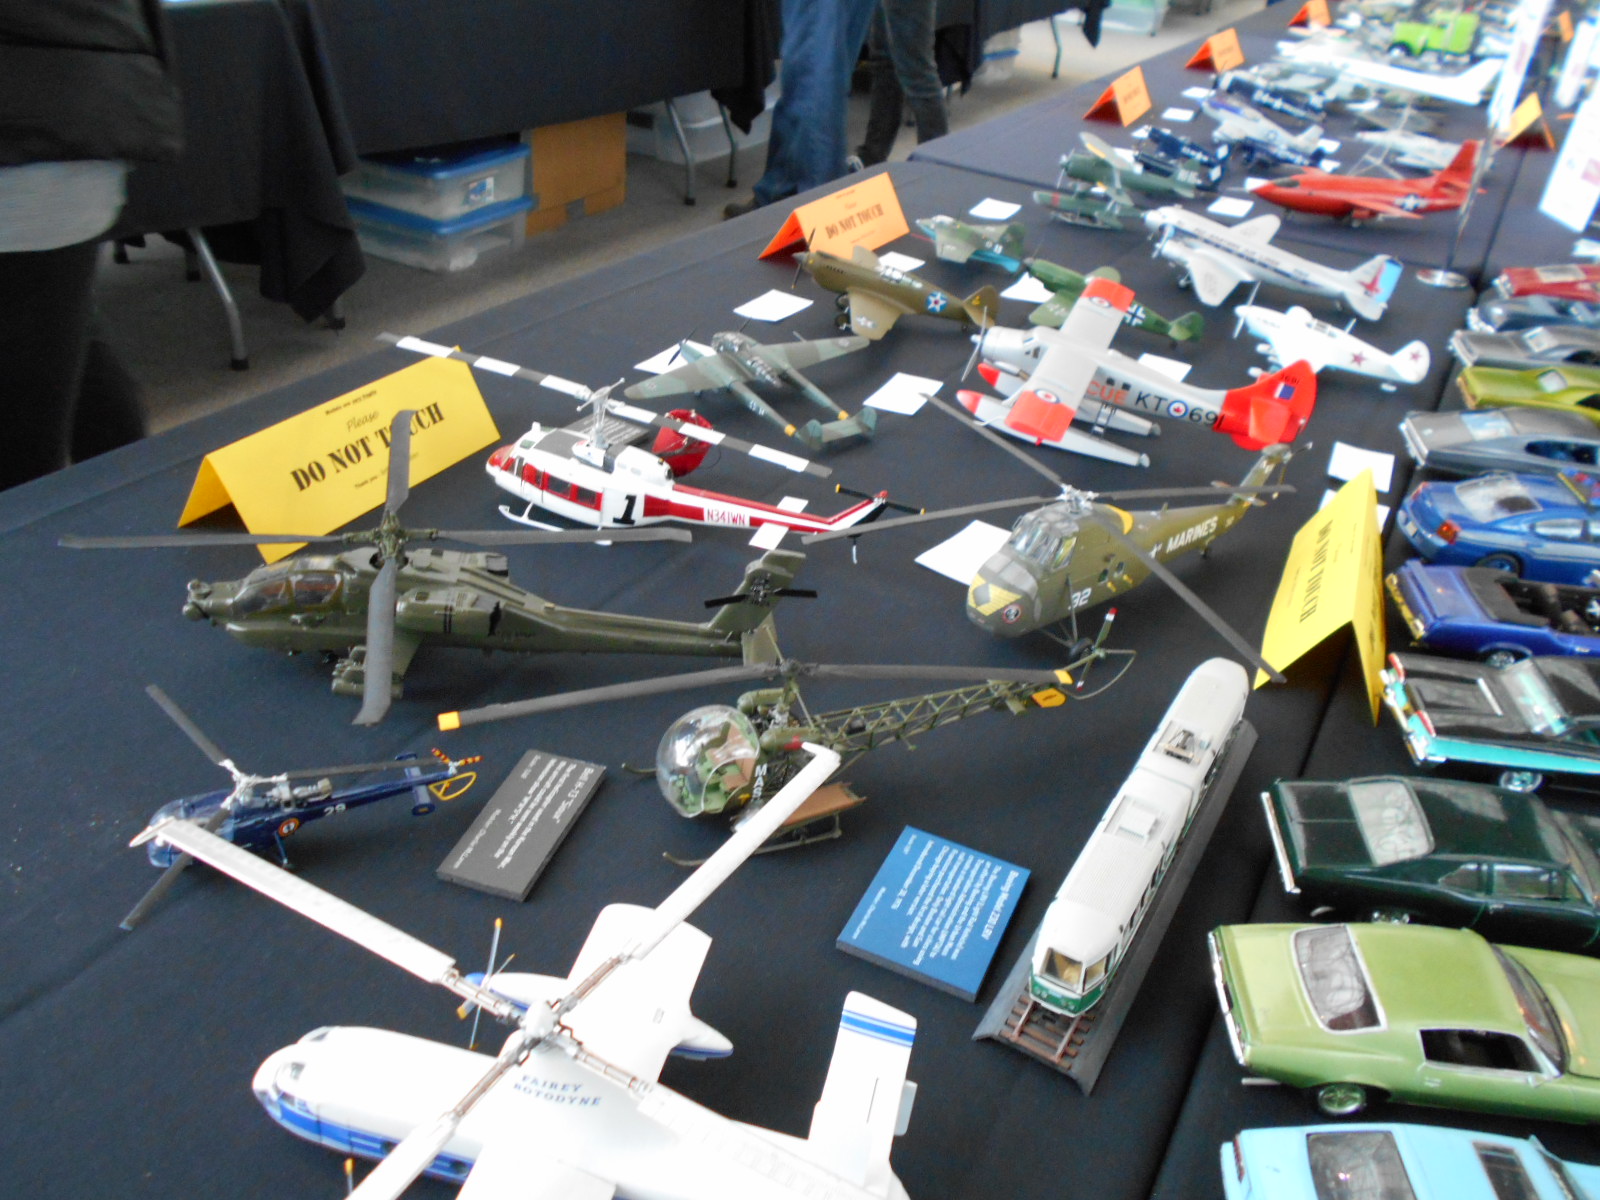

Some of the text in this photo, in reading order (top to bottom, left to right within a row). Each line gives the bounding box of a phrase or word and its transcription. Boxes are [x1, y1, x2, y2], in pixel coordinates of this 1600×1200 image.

[825, 223, 840, 239] DO
[838, 215, 857, 232] NOT
[856, 203, 884, 224] TOUCH
[347, 411, 379, 432] Please
[1135, 391, 1225, 429] KT 691
[290, 402, 444, 491] DO NOT TUCH
[613, 494, 637, 525] 1
[707, 509, 746, 526] N341WN
[1166, 515, 1219, 554] MARINES
[993, 891, 1009, 913] Model
[513, 1082, 602, 1107] ROTODYNE
[521, 1074, 583, 1092] FAIREY
